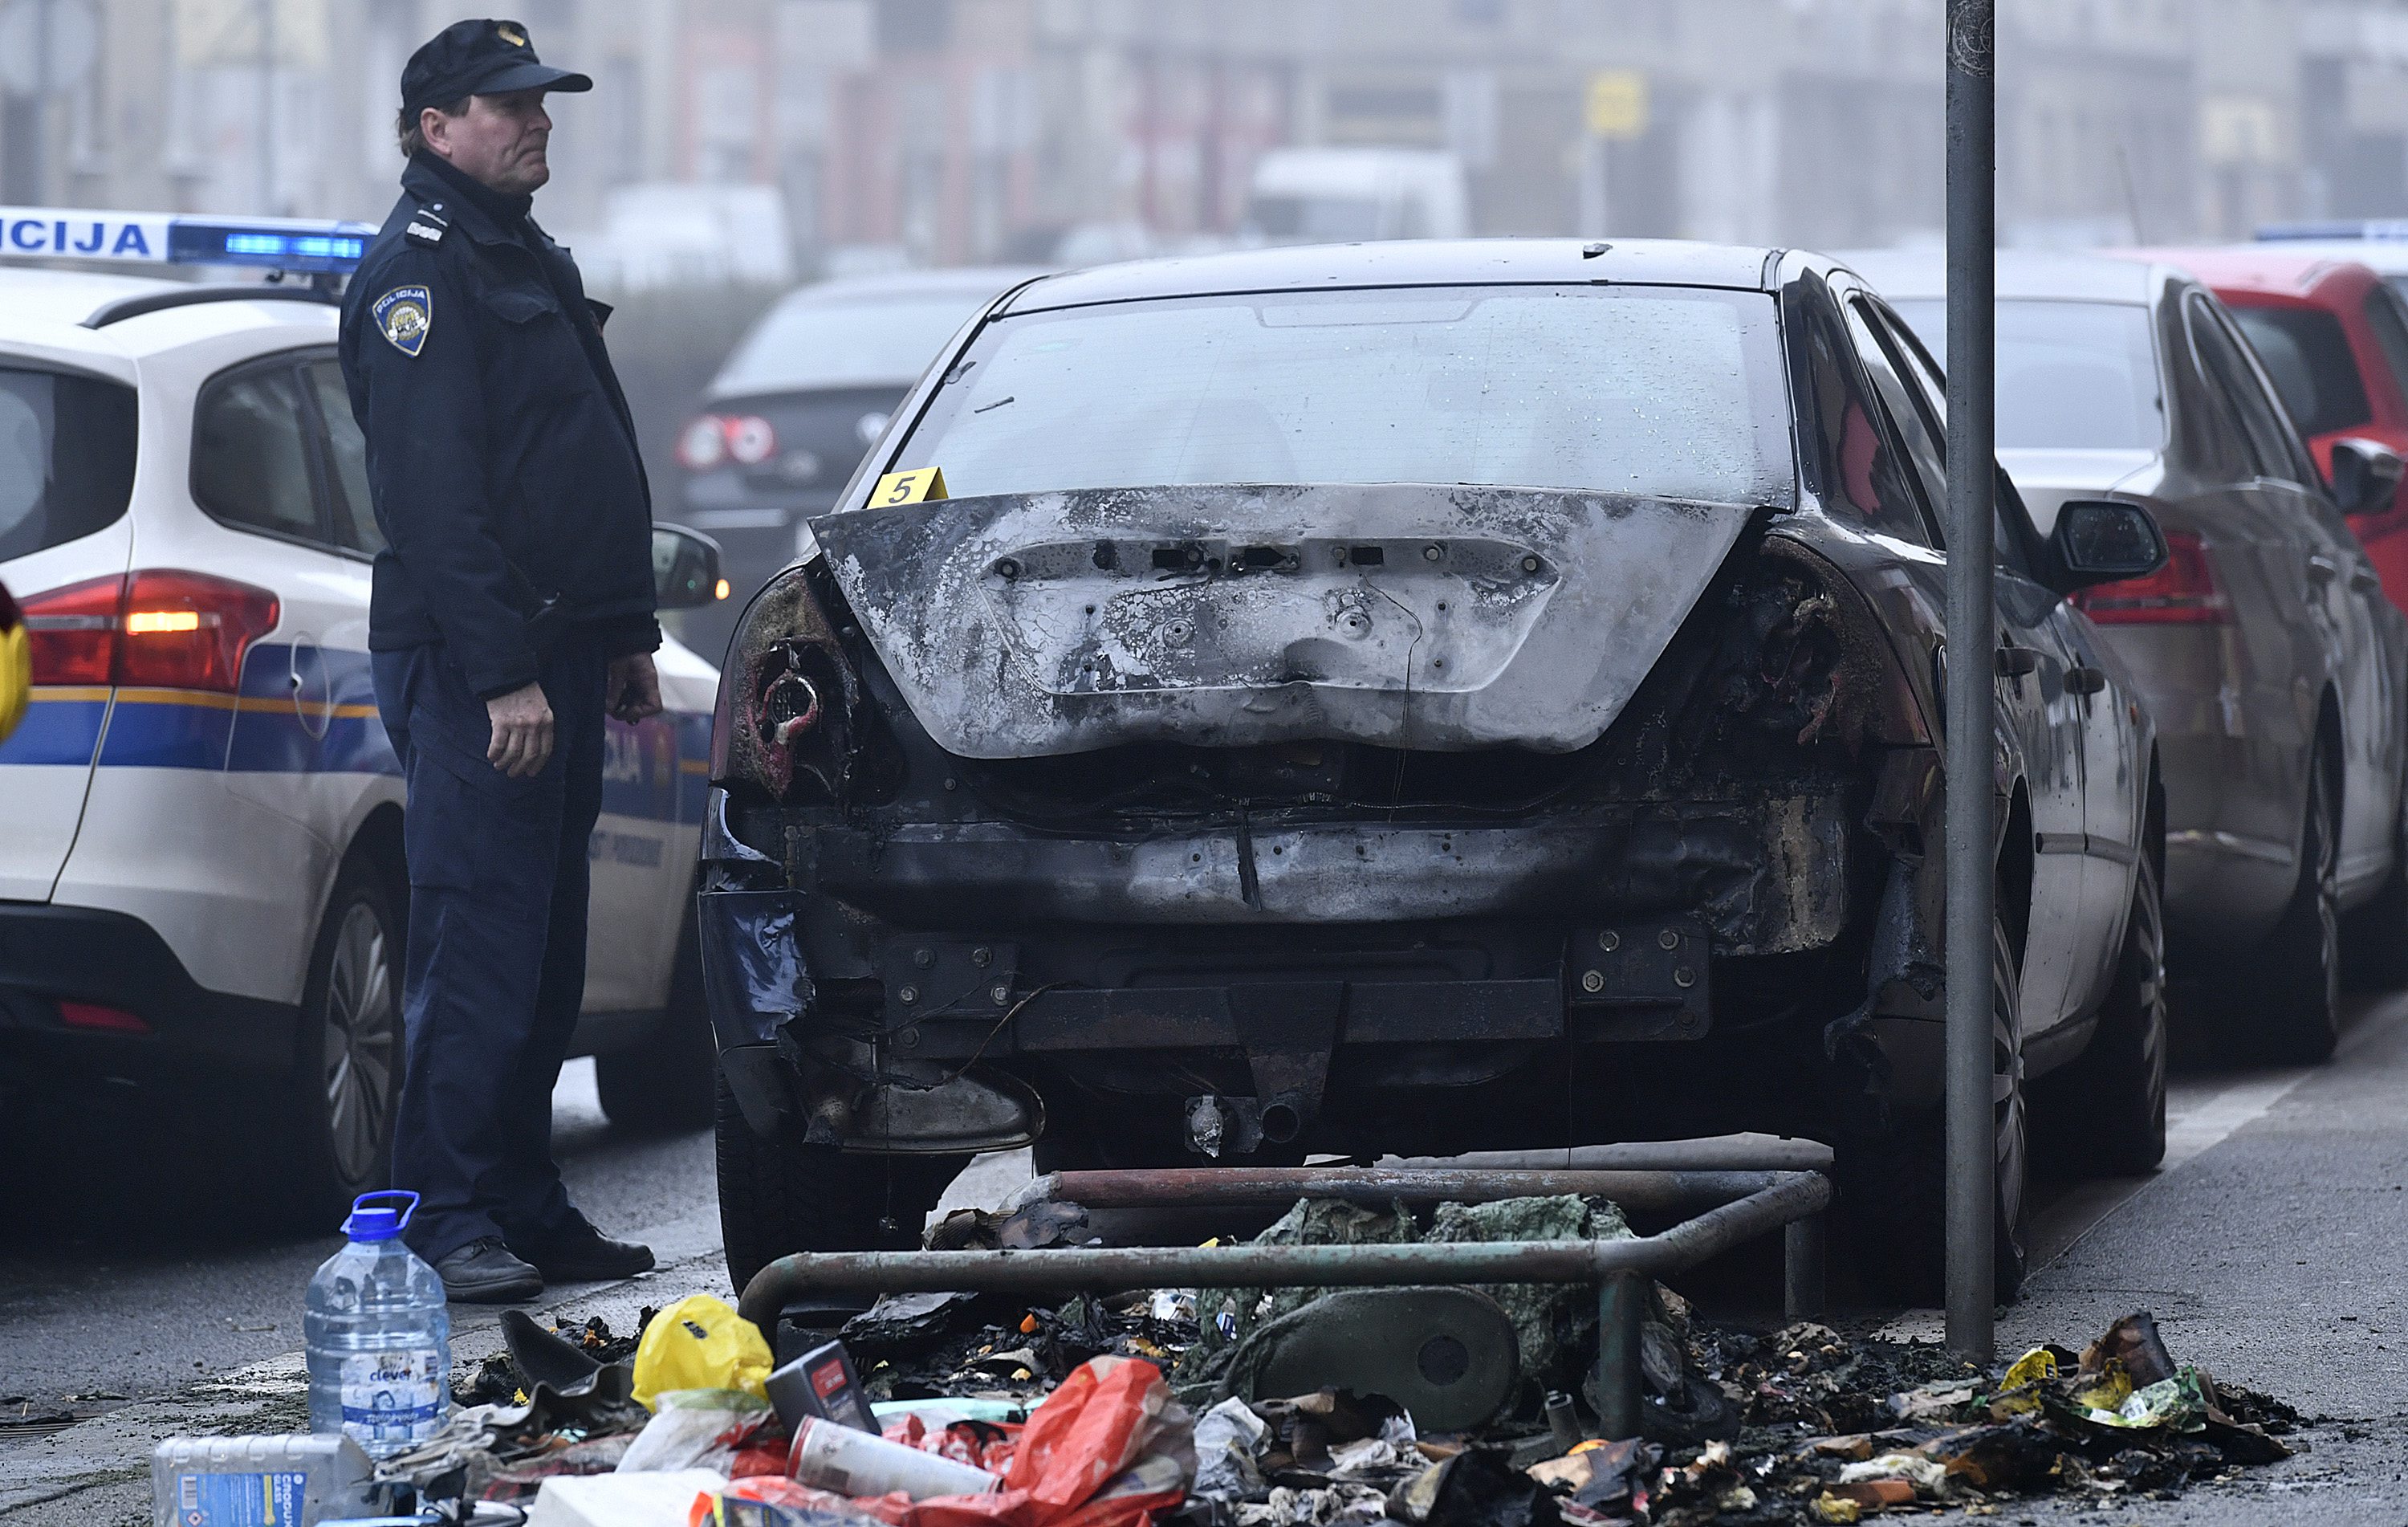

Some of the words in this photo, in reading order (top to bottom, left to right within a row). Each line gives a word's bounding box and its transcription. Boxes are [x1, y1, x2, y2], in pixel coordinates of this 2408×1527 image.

[0, 219, 149, 254] CIJA
[376, 289, 425, 314] POLICIJA
[888, 476, 917, 504] 5
[370, 1368, 412, 1381] clever
